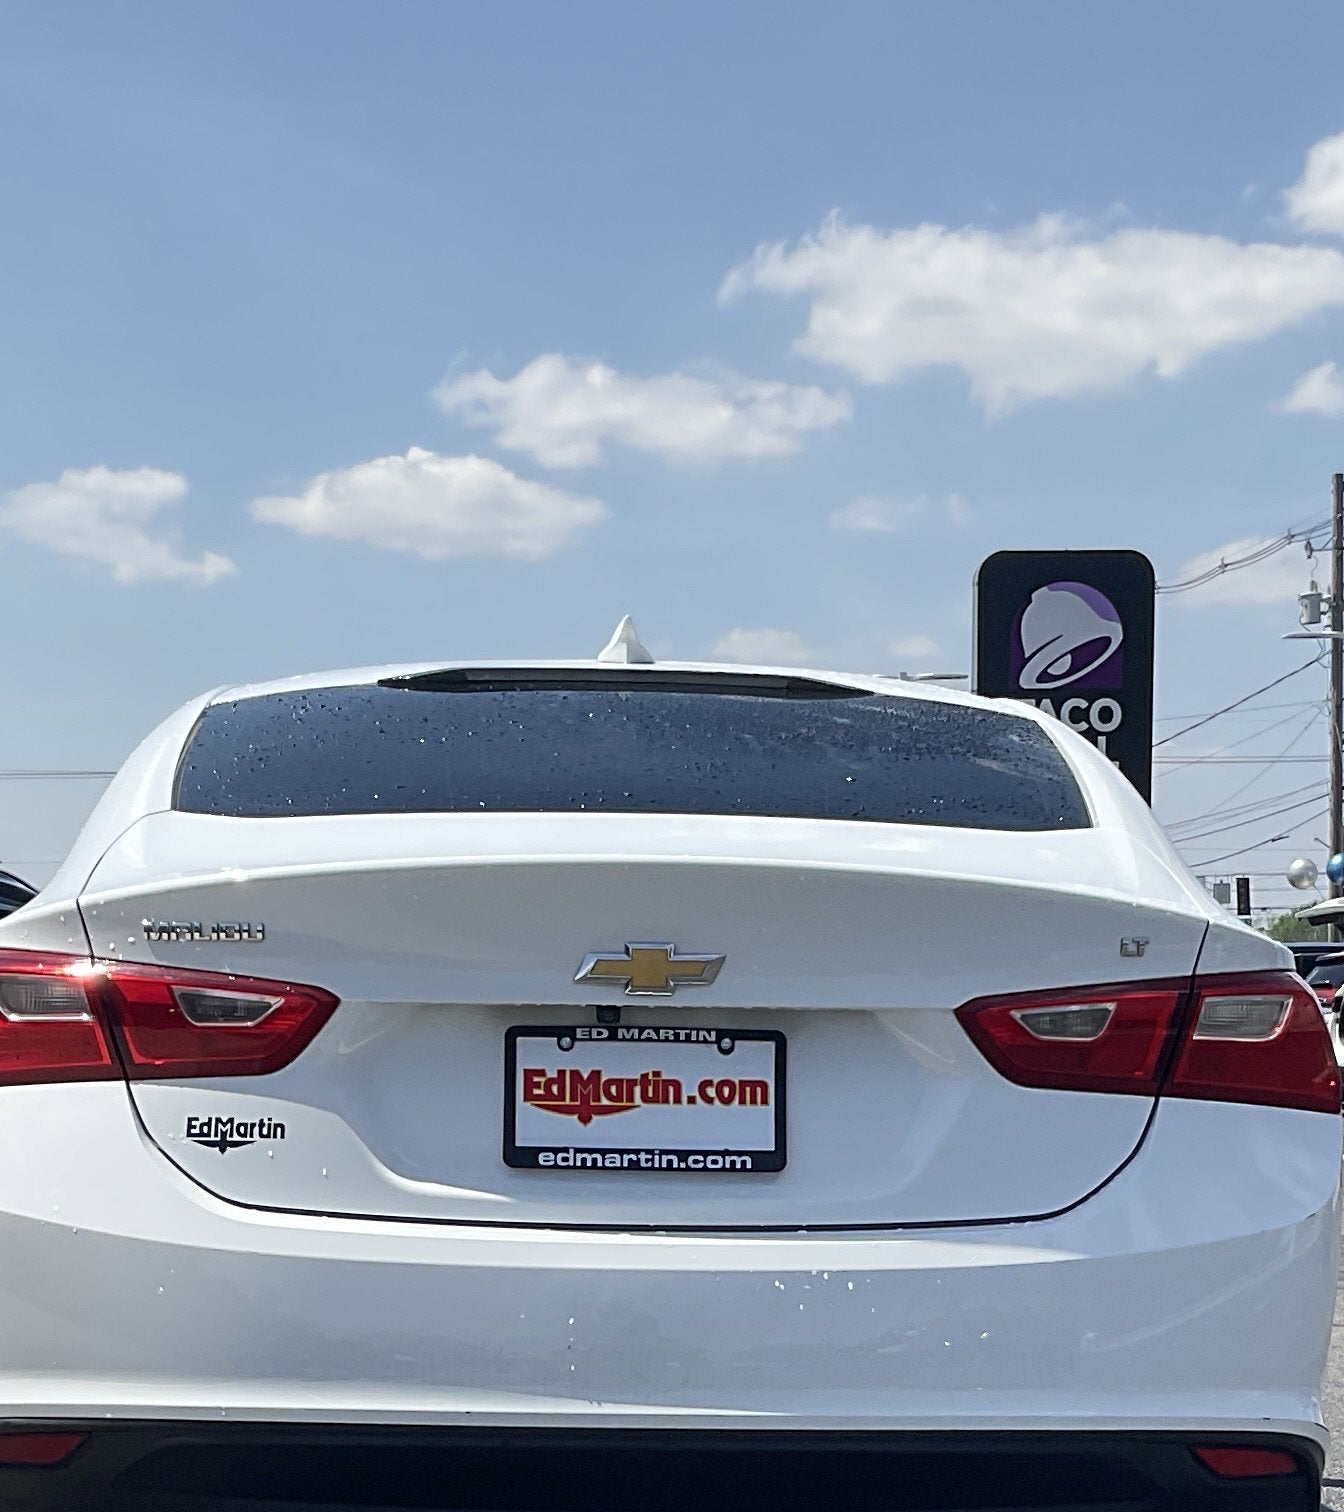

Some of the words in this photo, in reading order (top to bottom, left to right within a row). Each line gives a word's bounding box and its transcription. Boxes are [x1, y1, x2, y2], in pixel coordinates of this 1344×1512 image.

[1018, 698, 1123, 733] ACO
[142, 920, 265, 942] MALIBU
[1120, 936, 1150, 957] LT
[576, 1028, 609, 1039] ED
[618, 1029, 716, 1041] MARTIN
[523, 1068, 769, 1106] EdMartin.com
[186, 1117, 286, 1139] EdMartin
[538, 1149, 752, 1169] edmartin.com
